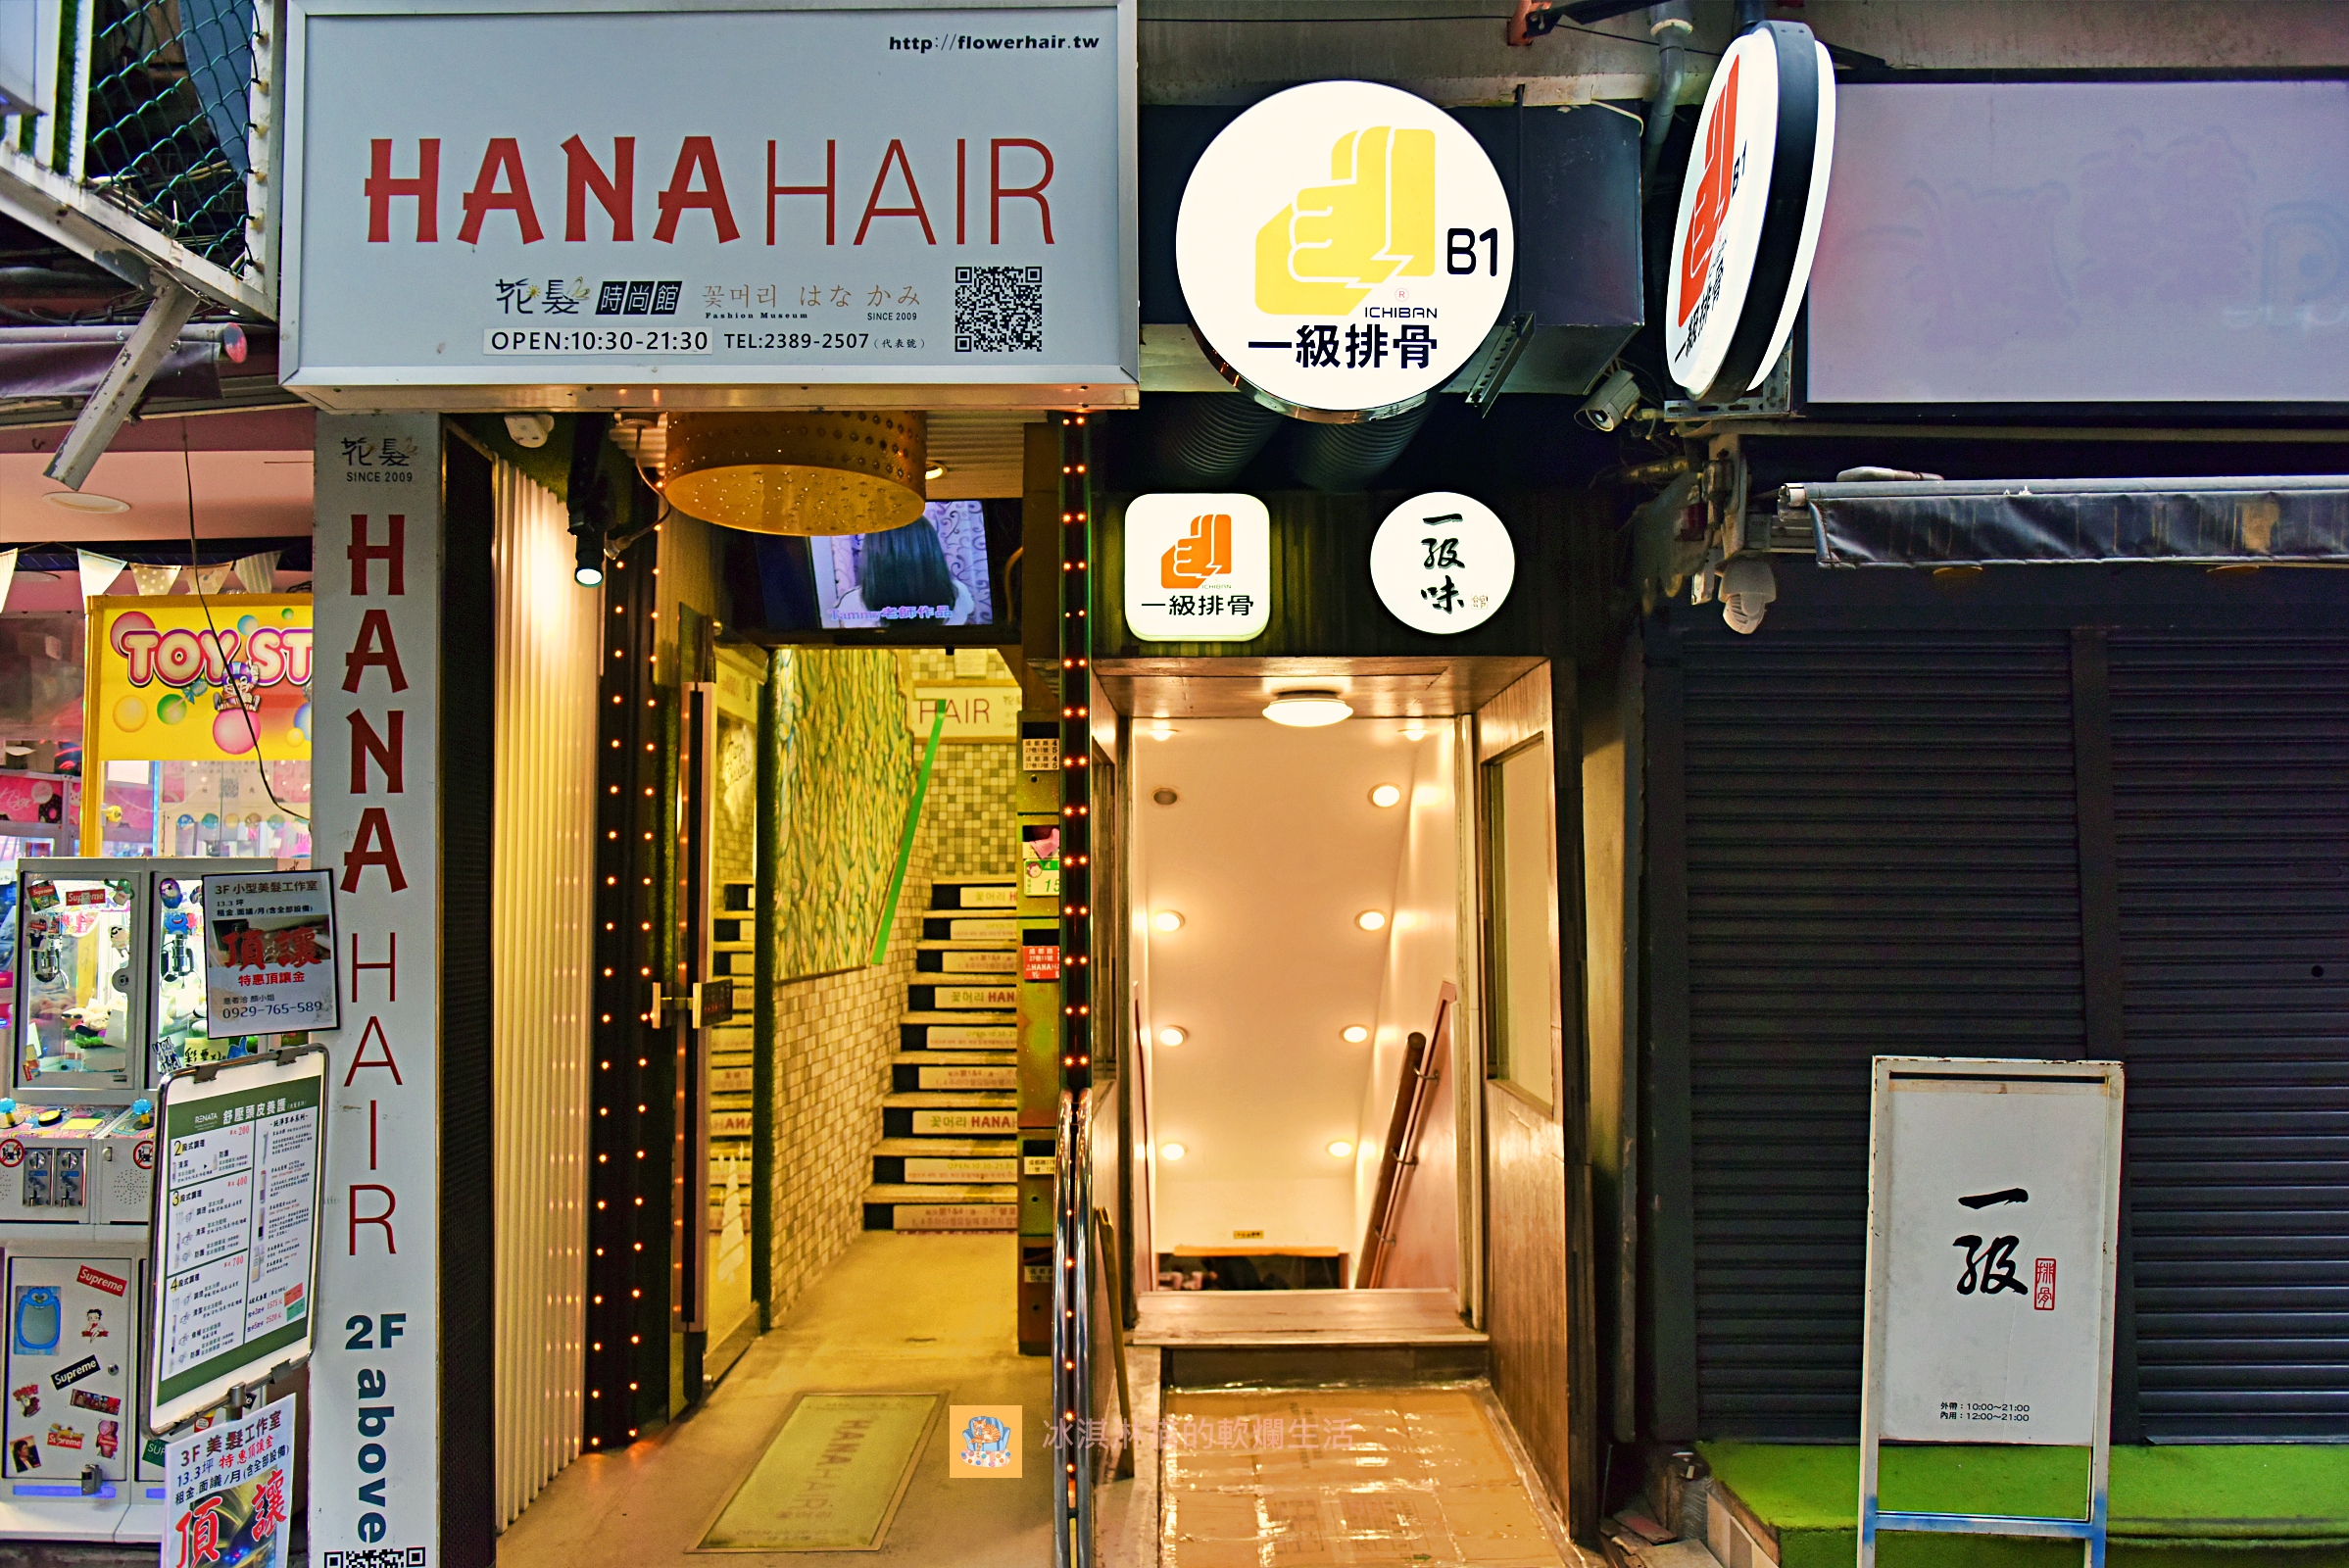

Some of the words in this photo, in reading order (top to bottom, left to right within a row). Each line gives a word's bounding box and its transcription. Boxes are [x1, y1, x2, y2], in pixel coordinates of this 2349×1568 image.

[889, 34, 1100, 53] http://flowerhair.tw
[1446, 227, 1499, 276] B1
[702, 284, 778, 310] 꽃머리
[867, 312, 893, 321] SINCE
[895, 312, 917, 321] 2009
[1363, 306, 1438, 319] ICHIBAN
[491, 330, 709, 352] OPEN:10:30-21:30
[1248, 323, 1439, 369] 一級排骨
[340, 437, 411, 466] 花髮
[346, 471, 381, 482] SINCE
[384, 471, 413, 482] 2009
[1141, 594, 1254, 616] 一級排骨
[120, 627, 241, 688] TOY
[68, 892, 104, 903] Supme
[215, 884, 230, 895] 3F
[233, 880, 318, 895] 小型美髮工作室
[238, 971, 306, 987] 特惠頂讓金
[222, 1001, 322, 1019] 0929-765-589
[194, 1112, 219, 1124] RENATA
[931, 1115, 967, 1128] 꽃머리
[971, 1116, 1010, 1128] HANA
[78, 1268, 123, 1292] Supreme
[345, 1312, 407, 1350] 2F
[54, 1358, 97, 1386] Supreme
[180, 1444, 201, 1467] 3F
[206, 1410, 281, 1457] 美髮工作室
[219, 1435, 274, 1469] 特惠頂讓金
[357, 1367, 395, 1544] above
